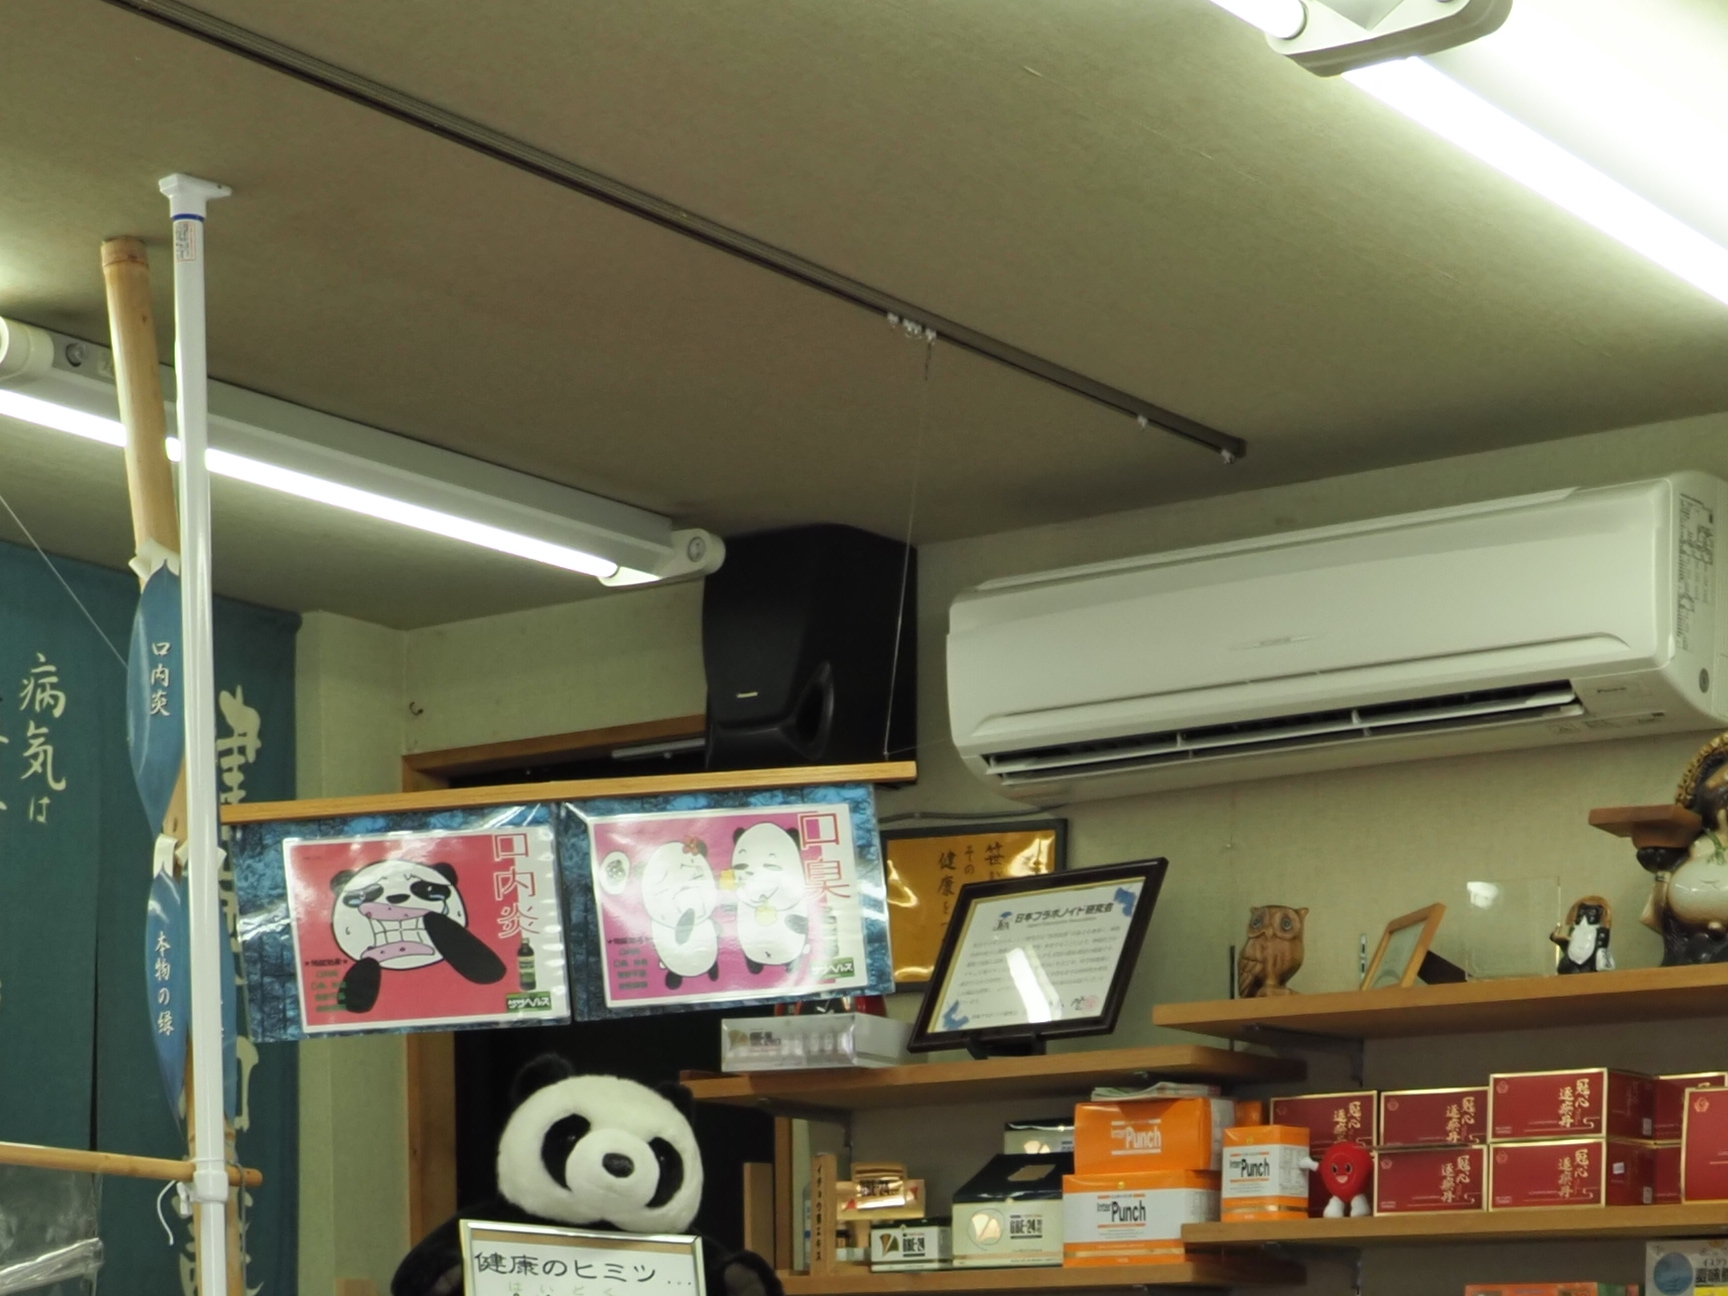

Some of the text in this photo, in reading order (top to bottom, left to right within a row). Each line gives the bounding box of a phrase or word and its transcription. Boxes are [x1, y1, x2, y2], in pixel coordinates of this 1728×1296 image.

[149, 640, 173, 718] 口内炎
[19, 652, 68, 826] 病気は
[491, 831, 542, 940] 口内炎
